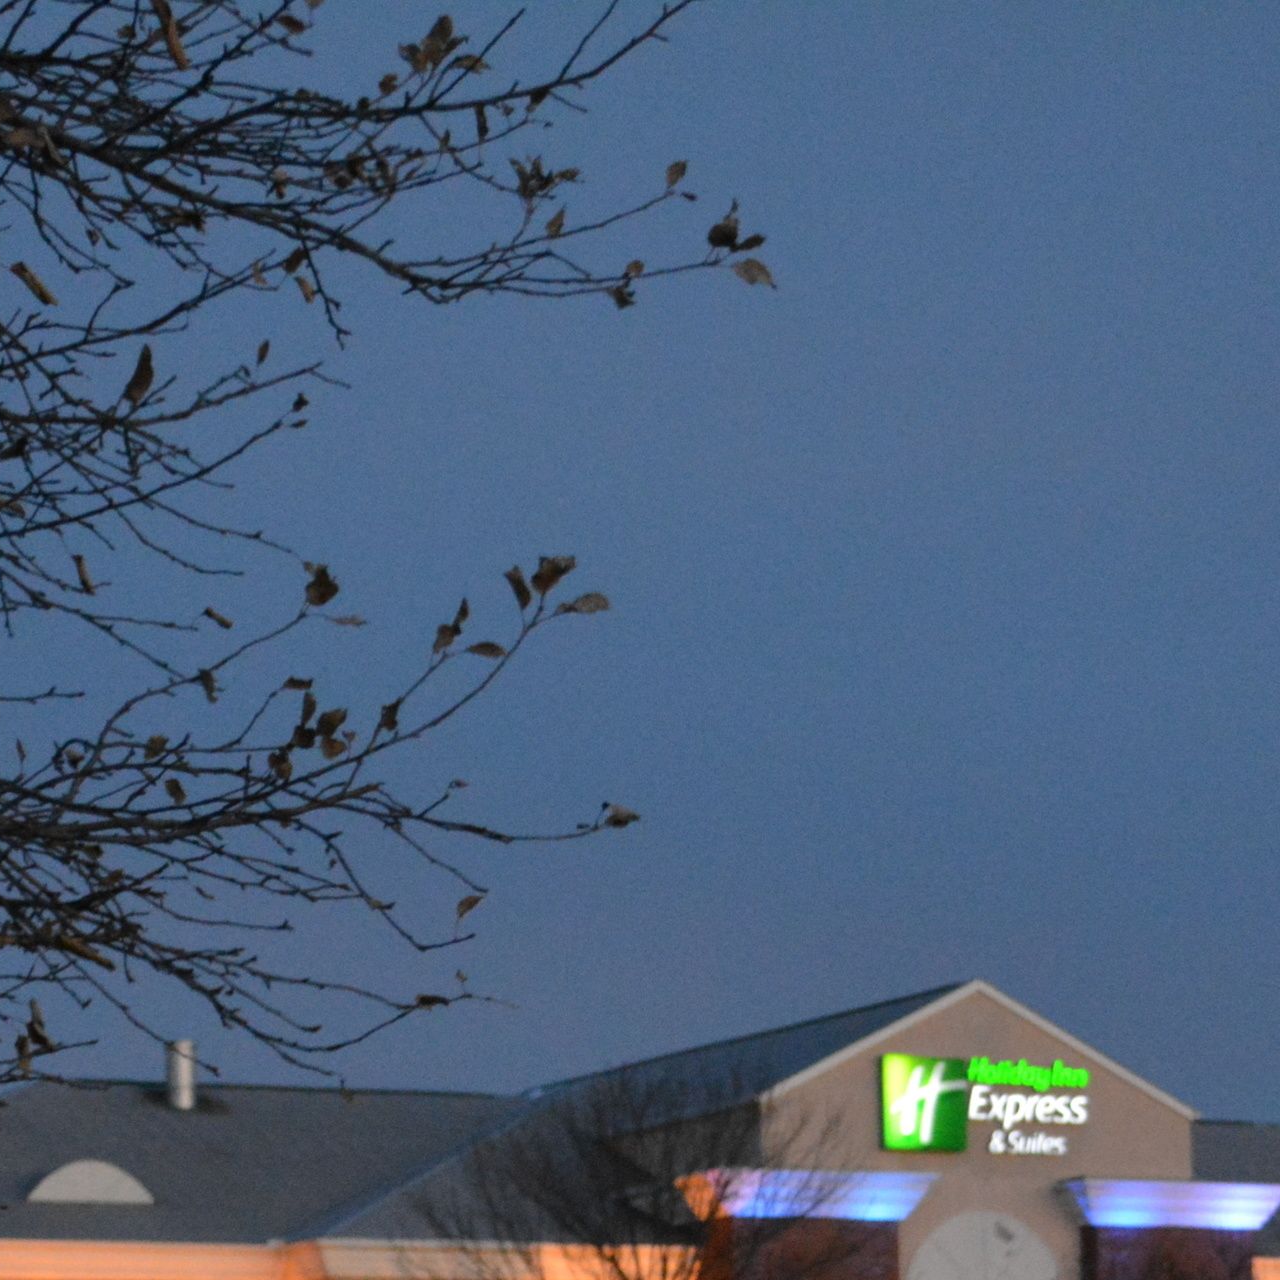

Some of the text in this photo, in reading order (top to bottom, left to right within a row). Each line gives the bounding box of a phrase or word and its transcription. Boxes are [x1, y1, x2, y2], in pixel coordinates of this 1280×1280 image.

[1052, 1060, 1089, 1088] Inn
[968, 1085, 1087, 1129] Express
[989, 1130, 1067, 1155] & Suites
